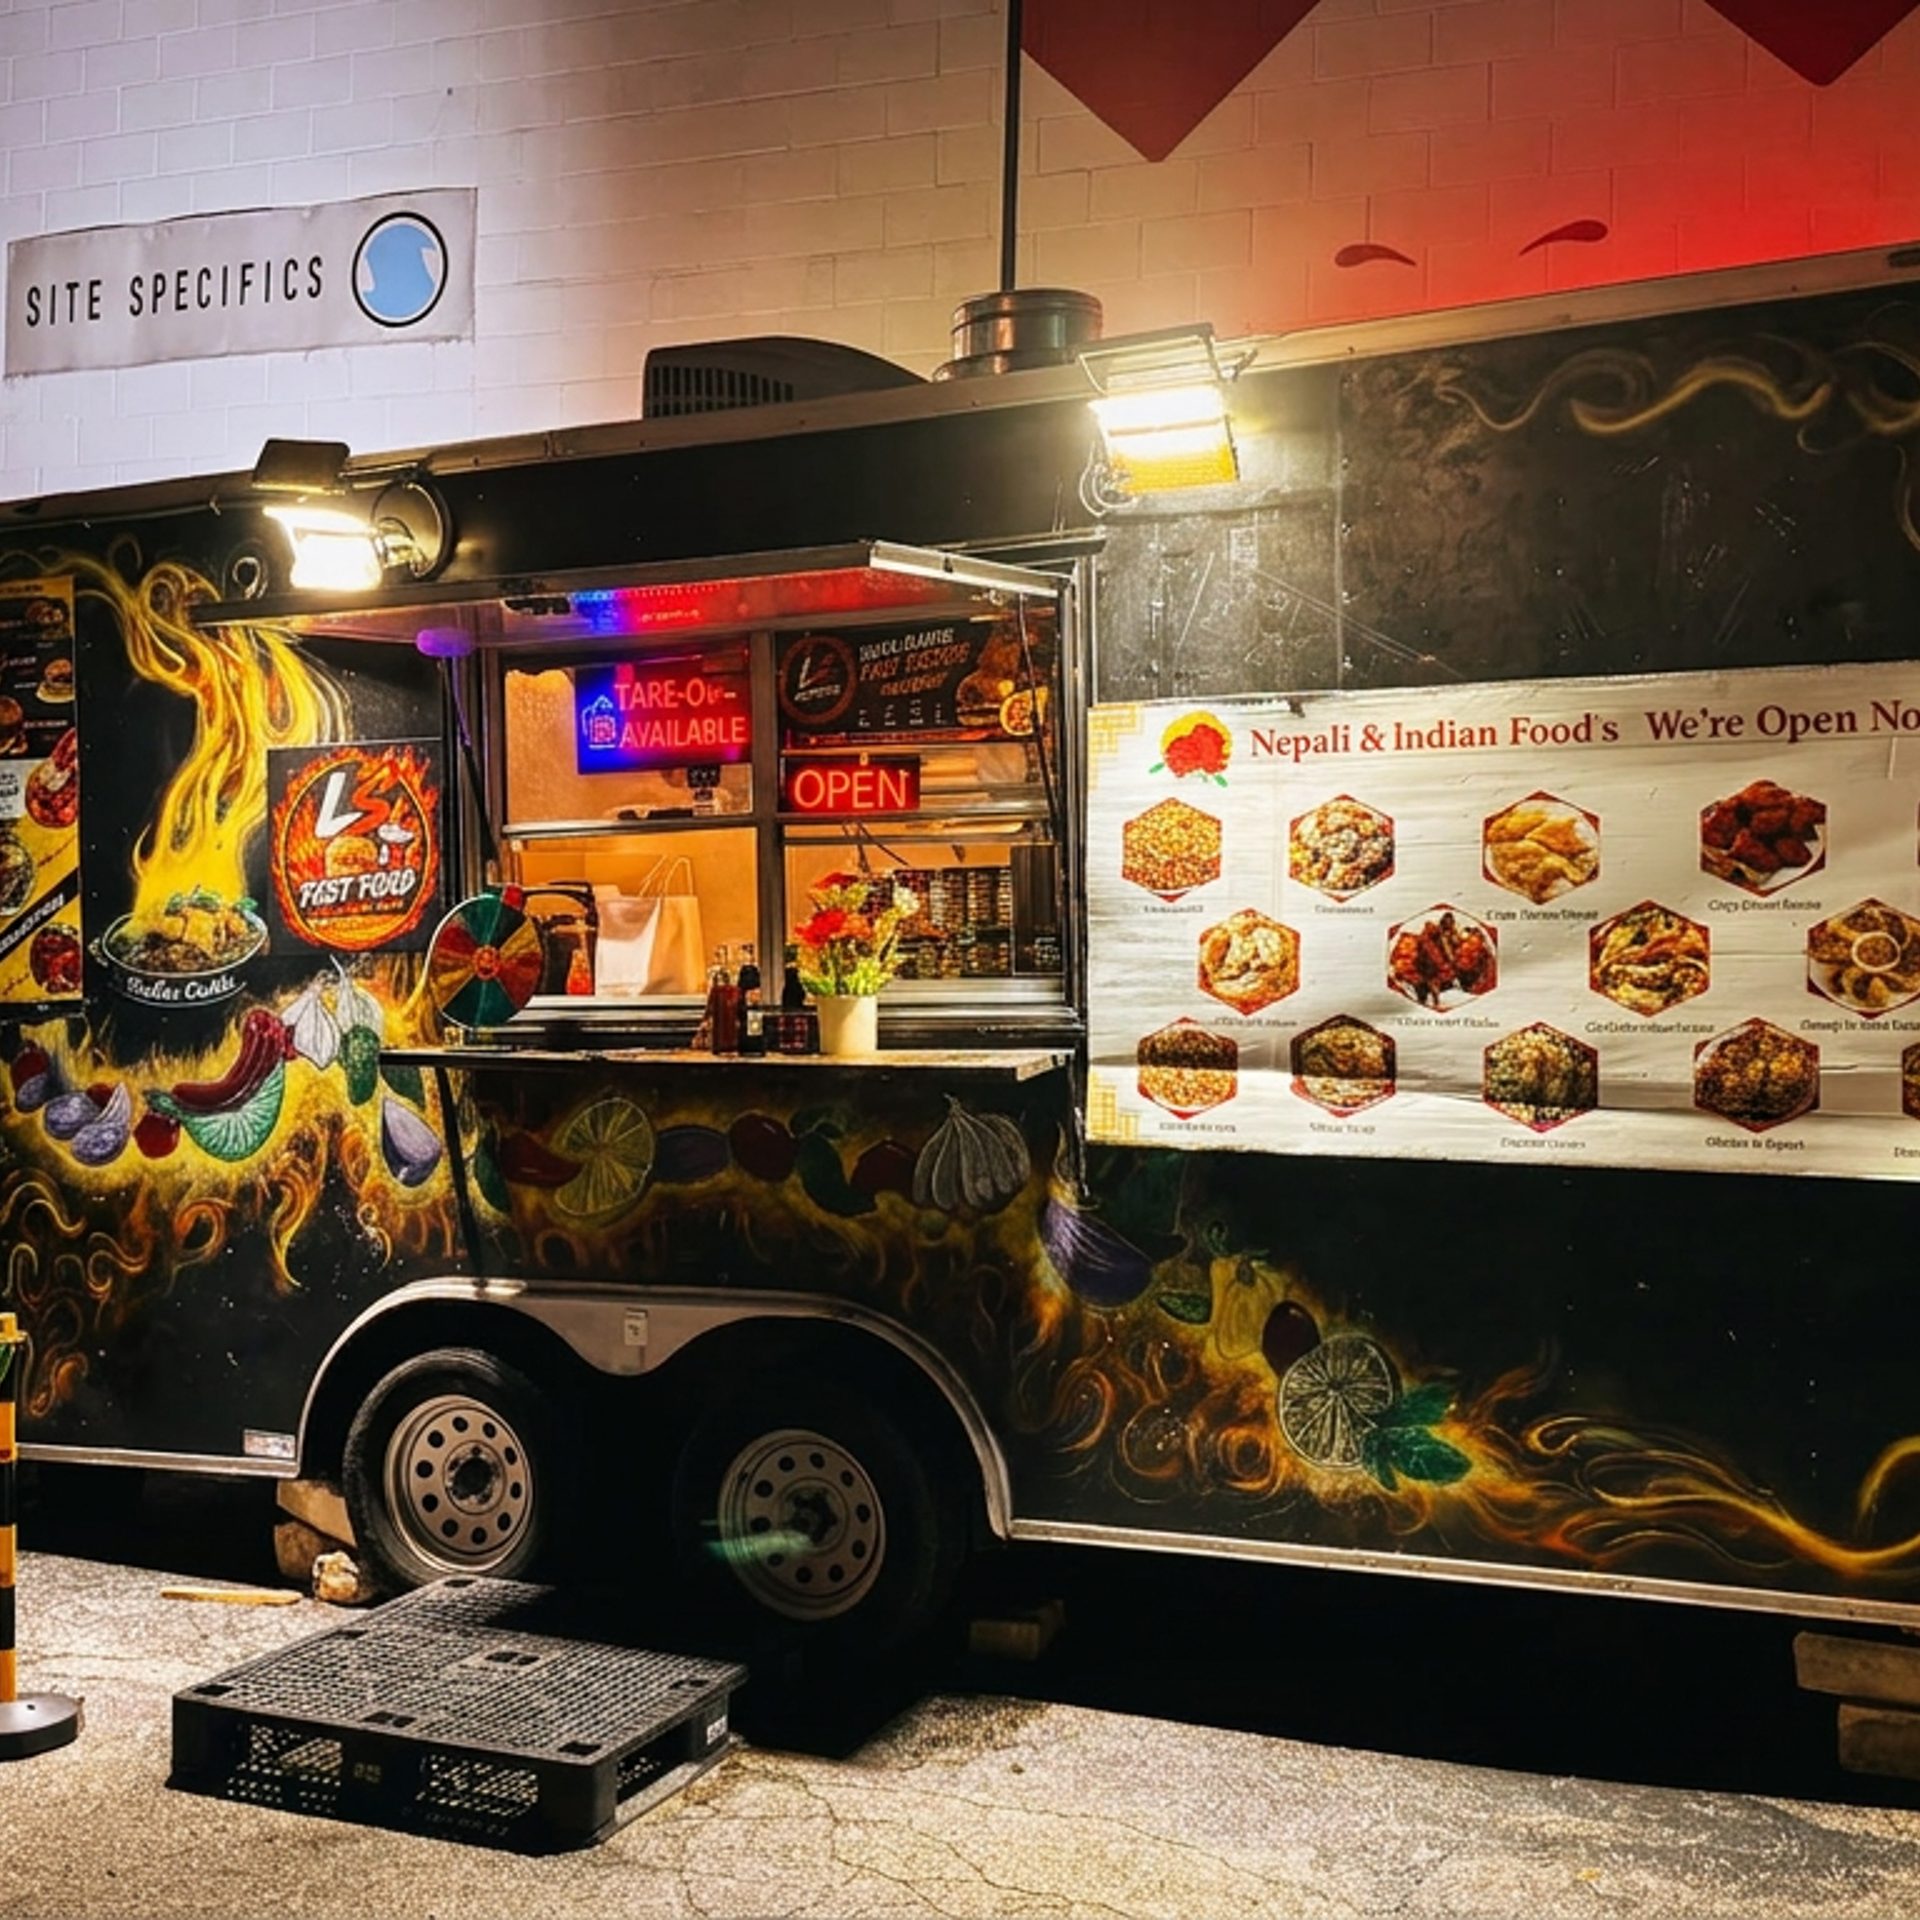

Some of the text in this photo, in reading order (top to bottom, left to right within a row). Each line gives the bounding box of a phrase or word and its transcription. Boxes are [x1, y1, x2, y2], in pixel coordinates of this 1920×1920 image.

[26, 256, 324, 327] SITE SPECIFICS
[619, 716, 748, 749] AVAILABLE
[1251, 724, 1351, 763] Nepali
[1360, 723, 1385, 752] &
[1394, 719, 1498, 751] Indian
[1509, 712, 1619, 746] Food's
[1645, 706, 1745, 741] We're
[1756, 704, 1858, 743] Open
[794, 768, 908, 809] OPEN
[300, 876, 355, 909] FAST
